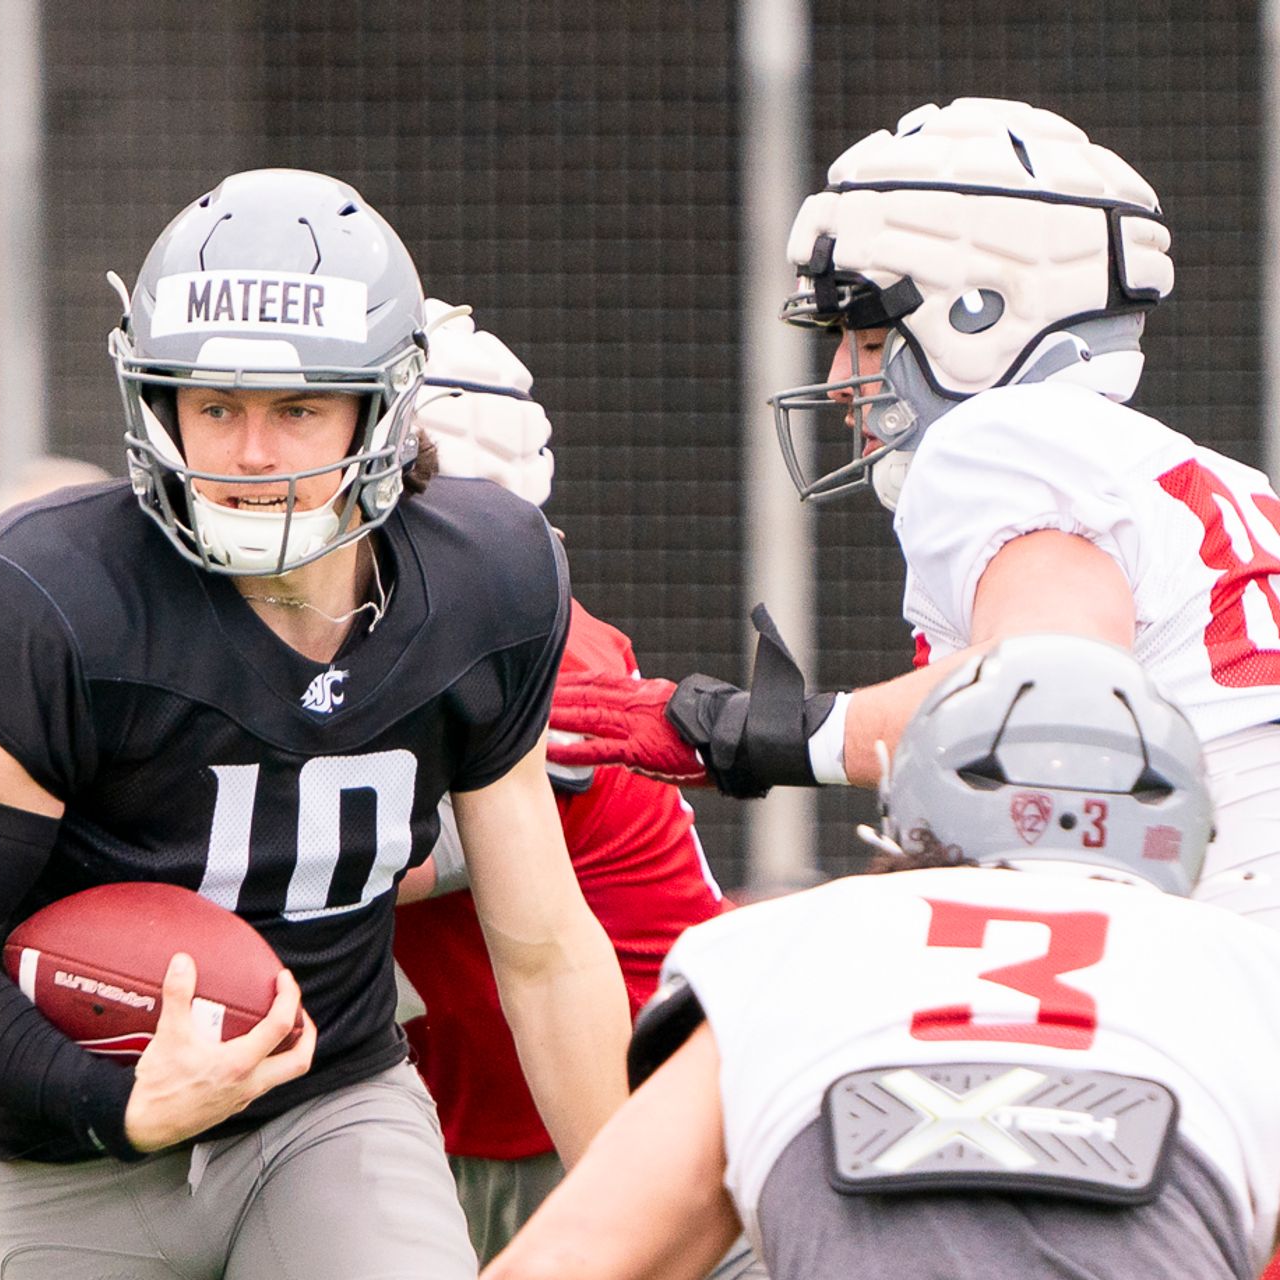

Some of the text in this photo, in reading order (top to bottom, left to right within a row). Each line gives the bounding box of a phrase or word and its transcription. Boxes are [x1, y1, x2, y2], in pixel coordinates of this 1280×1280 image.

[187, 279, 325, 327] MATEER
[197, 748, 419, 923] 10
[1082, 799, 1108, 848] 3
[909, 896, 1110, 1051] 3
